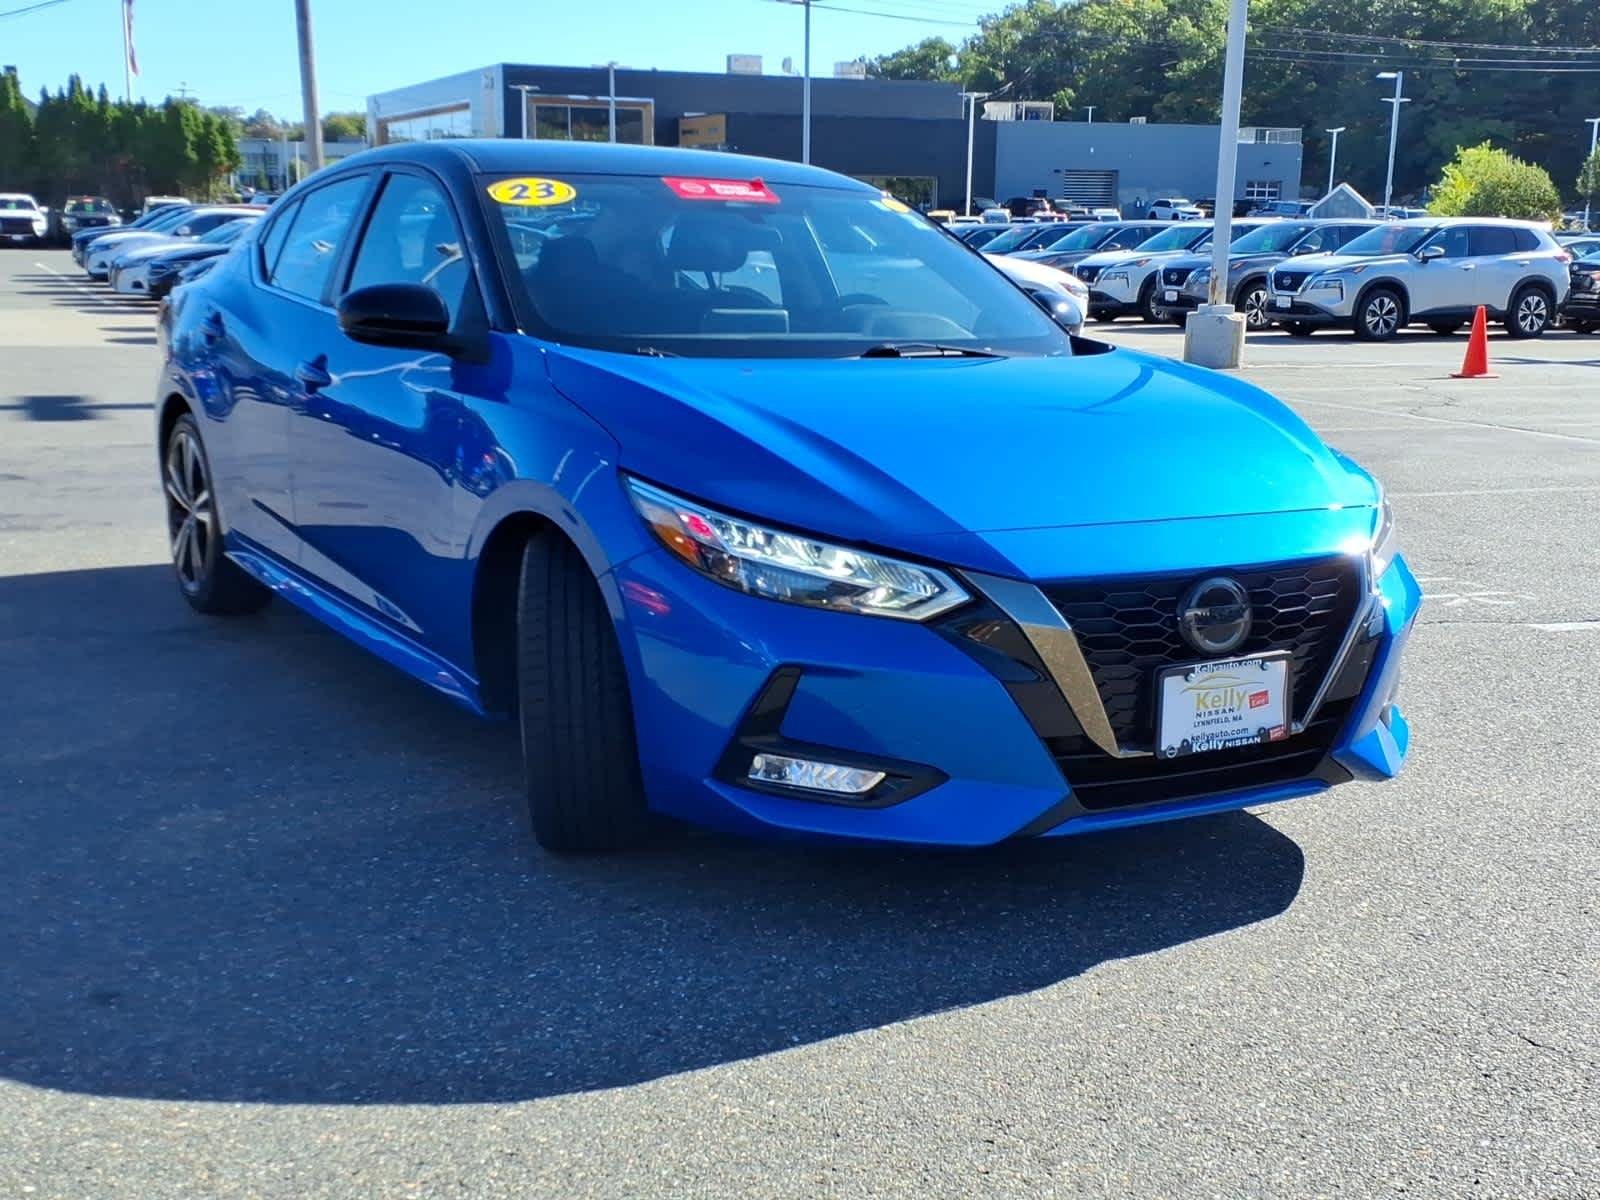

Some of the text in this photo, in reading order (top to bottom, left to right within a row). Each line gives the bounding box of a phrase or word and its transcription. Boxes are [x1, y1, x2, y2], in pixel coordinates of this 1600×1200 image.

[509, 183, 556, 200] 23
[1195, 688, 1248, 711] Kelly
[1195, 707, 1235, 718] NISSAN
[1232, 714, 1243, 722] MA
[1190, 727, 1249, 742] kellyauto.com
[1192, 736, 1262, 753] Kelly NISSAN
